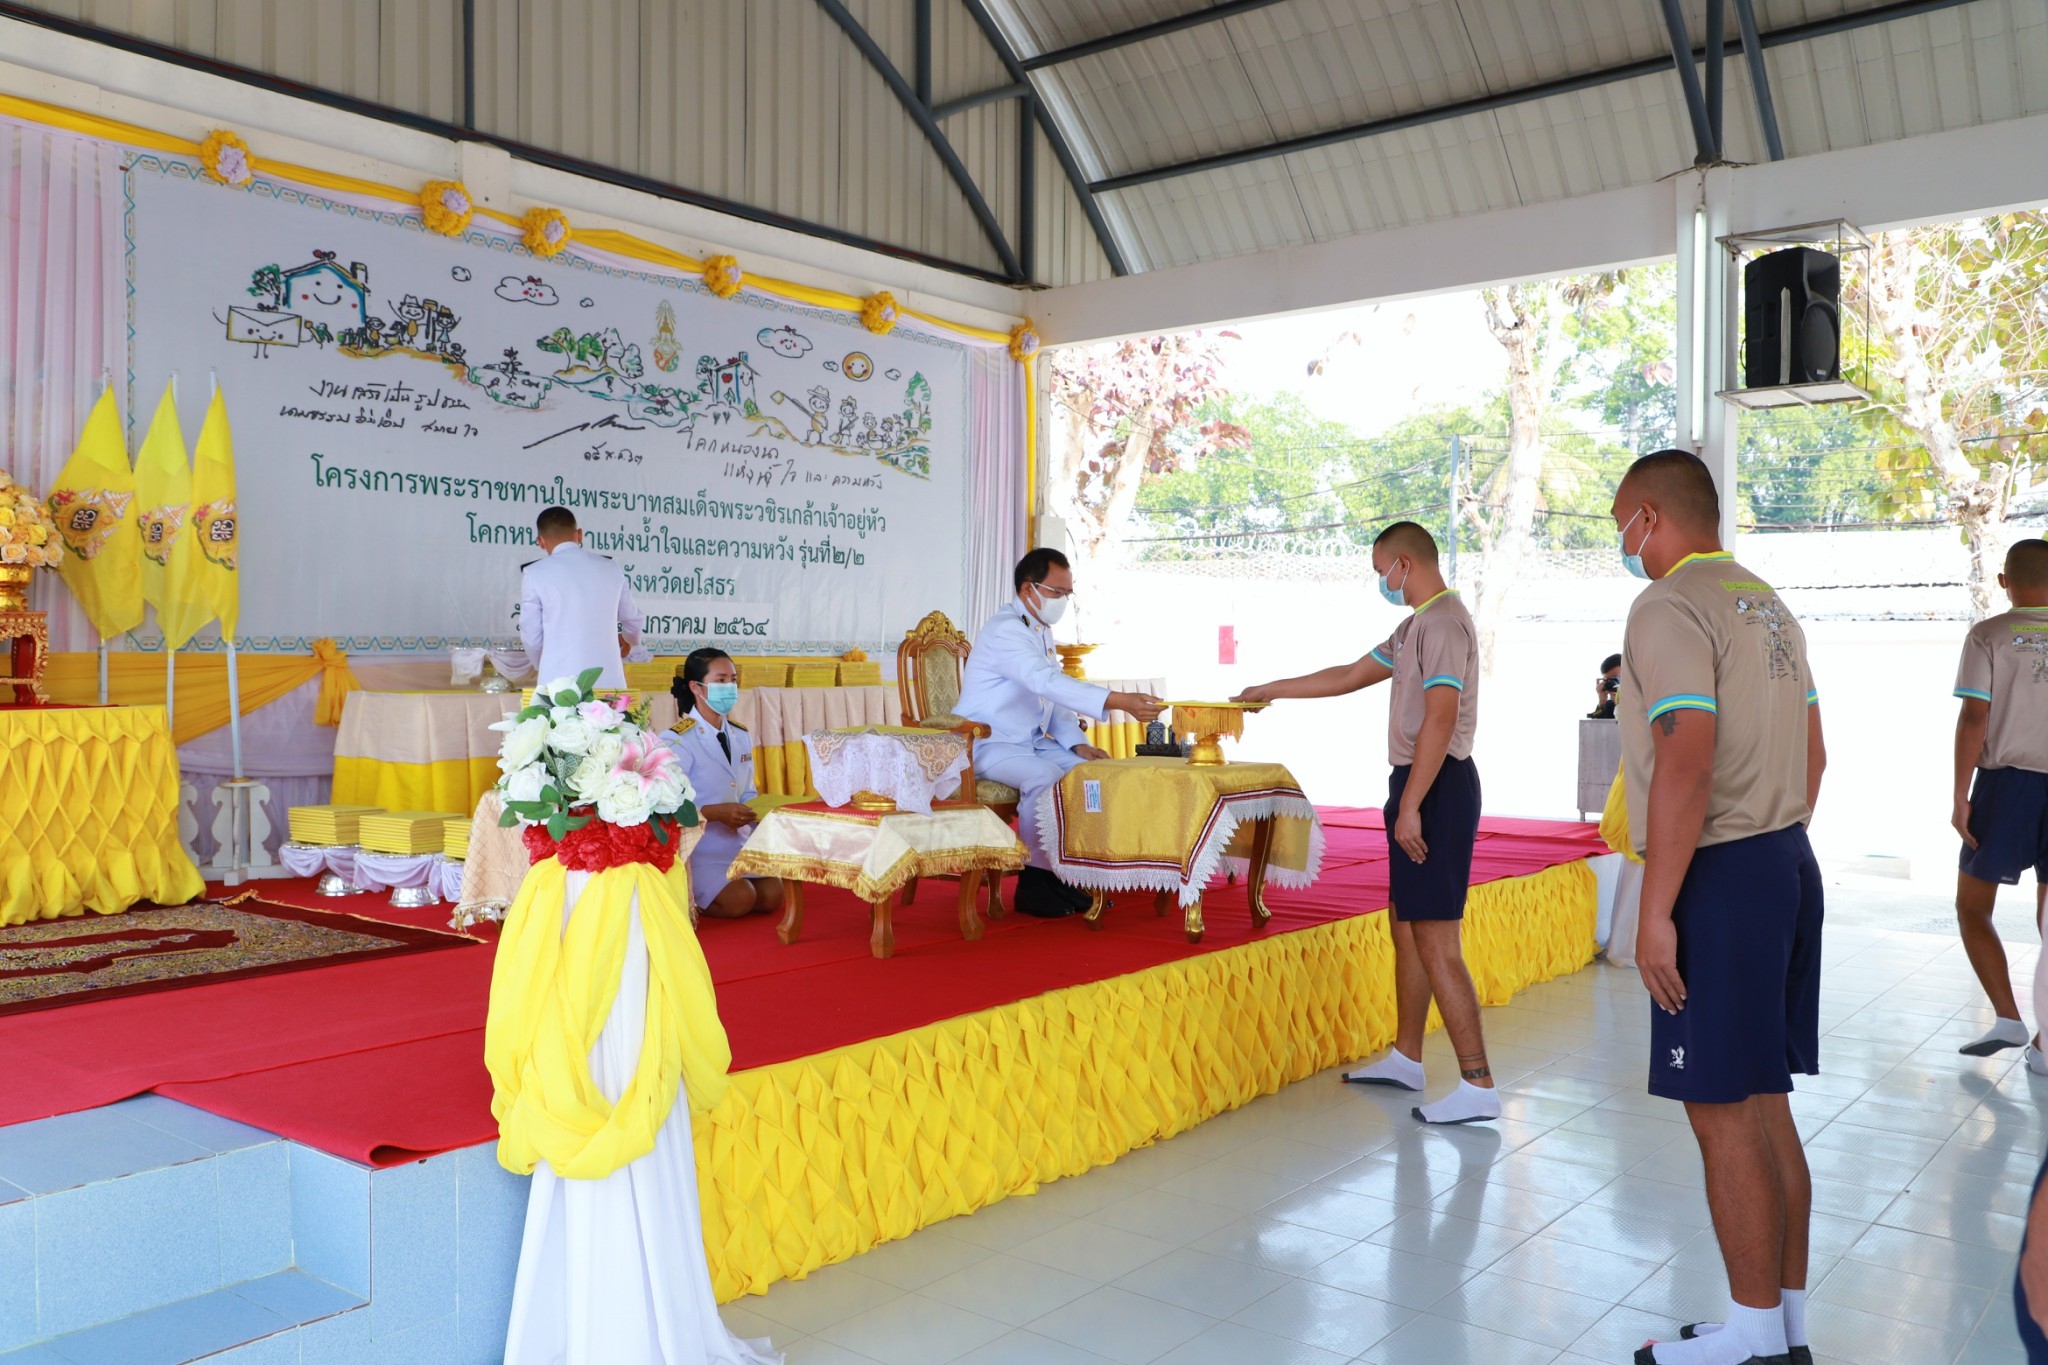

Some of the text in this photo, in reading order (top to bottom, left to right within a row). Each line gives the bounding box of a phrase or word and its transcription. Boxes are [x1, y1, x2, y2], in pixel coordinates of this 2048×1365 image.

[310, 452, 887, 540] โครงการพระราชทานในพระบาทสมเด็จพระวชิรเกล้าเจ้าอยู่หัว
[714, 616, 770, 637] ๒๕๖๔
